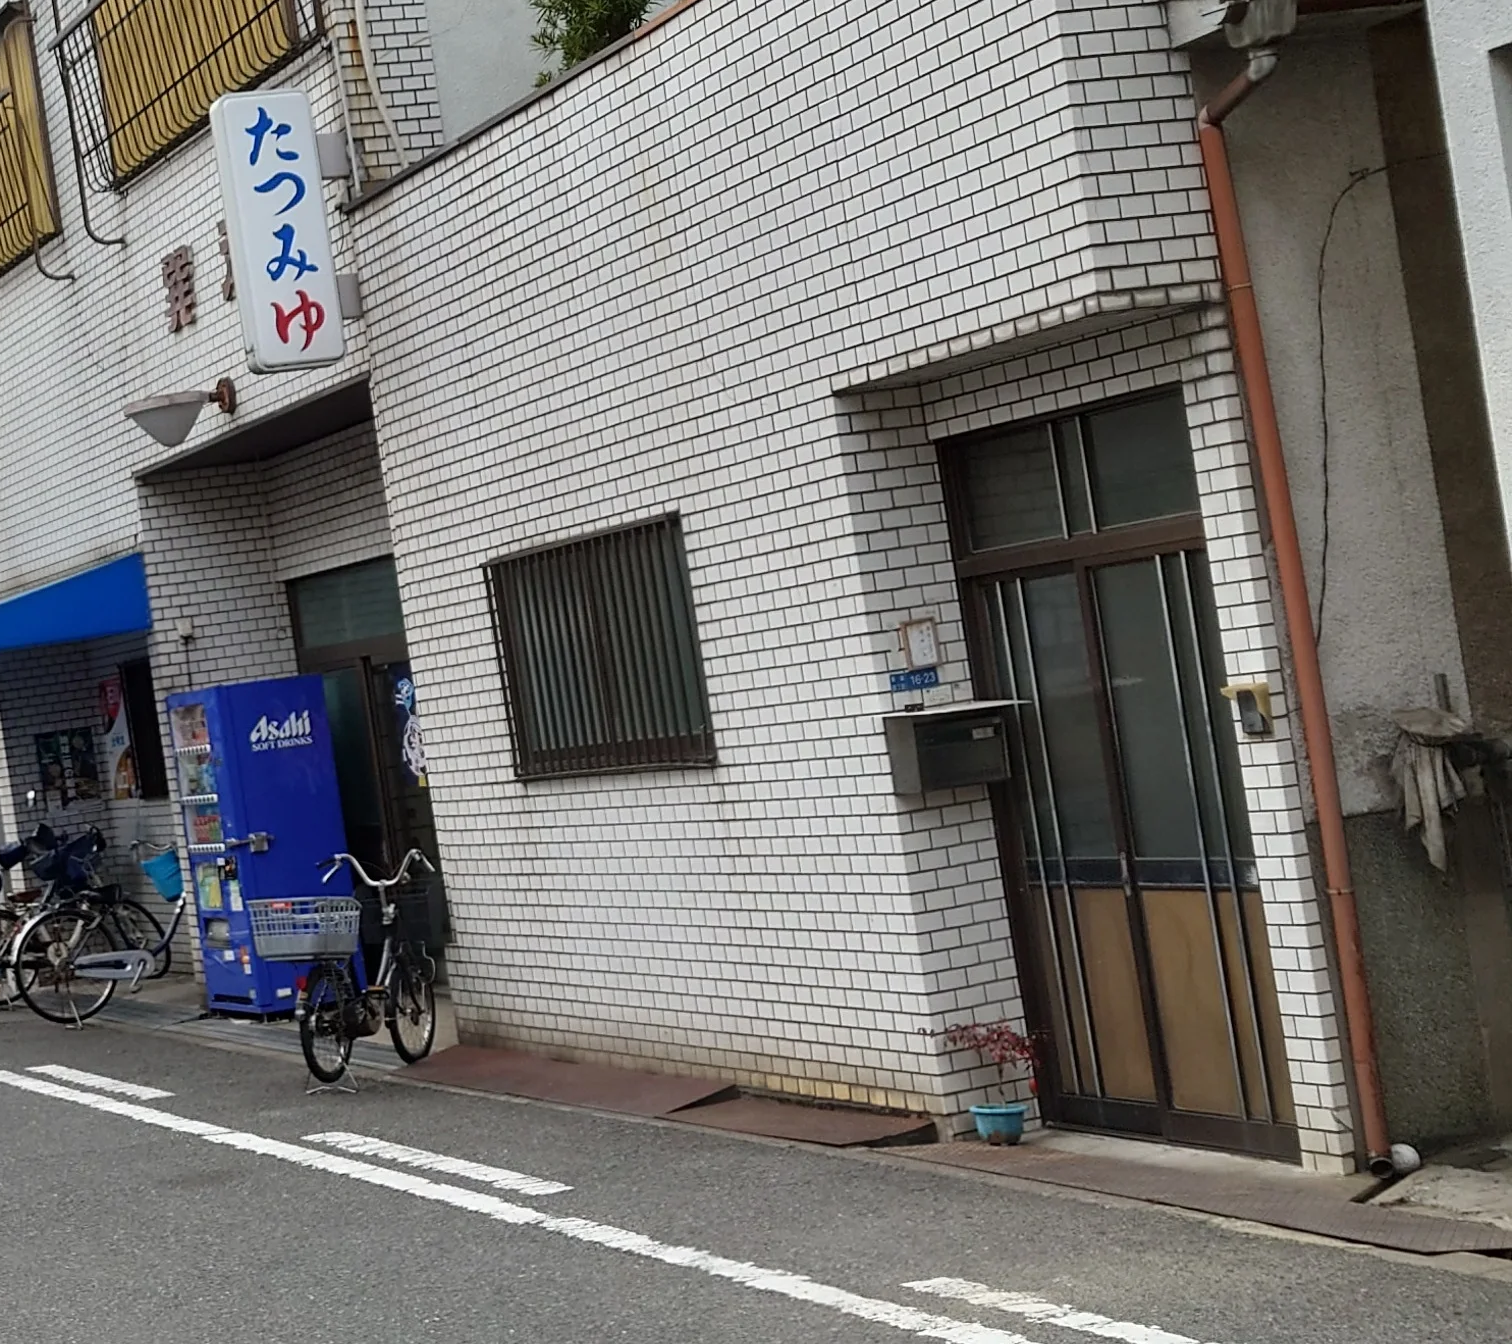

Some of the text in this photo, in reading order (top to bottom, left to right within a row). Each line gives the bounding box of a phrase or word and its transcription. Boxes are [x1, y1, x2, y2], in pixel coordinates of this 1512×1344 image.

[245, 106, 326, 353] たつみゆ
[910, 671, 937, 686] 16-23
[250, 709, 312, 743] Asahi
[252, 736, 314, 752] SOFT DRINKS
